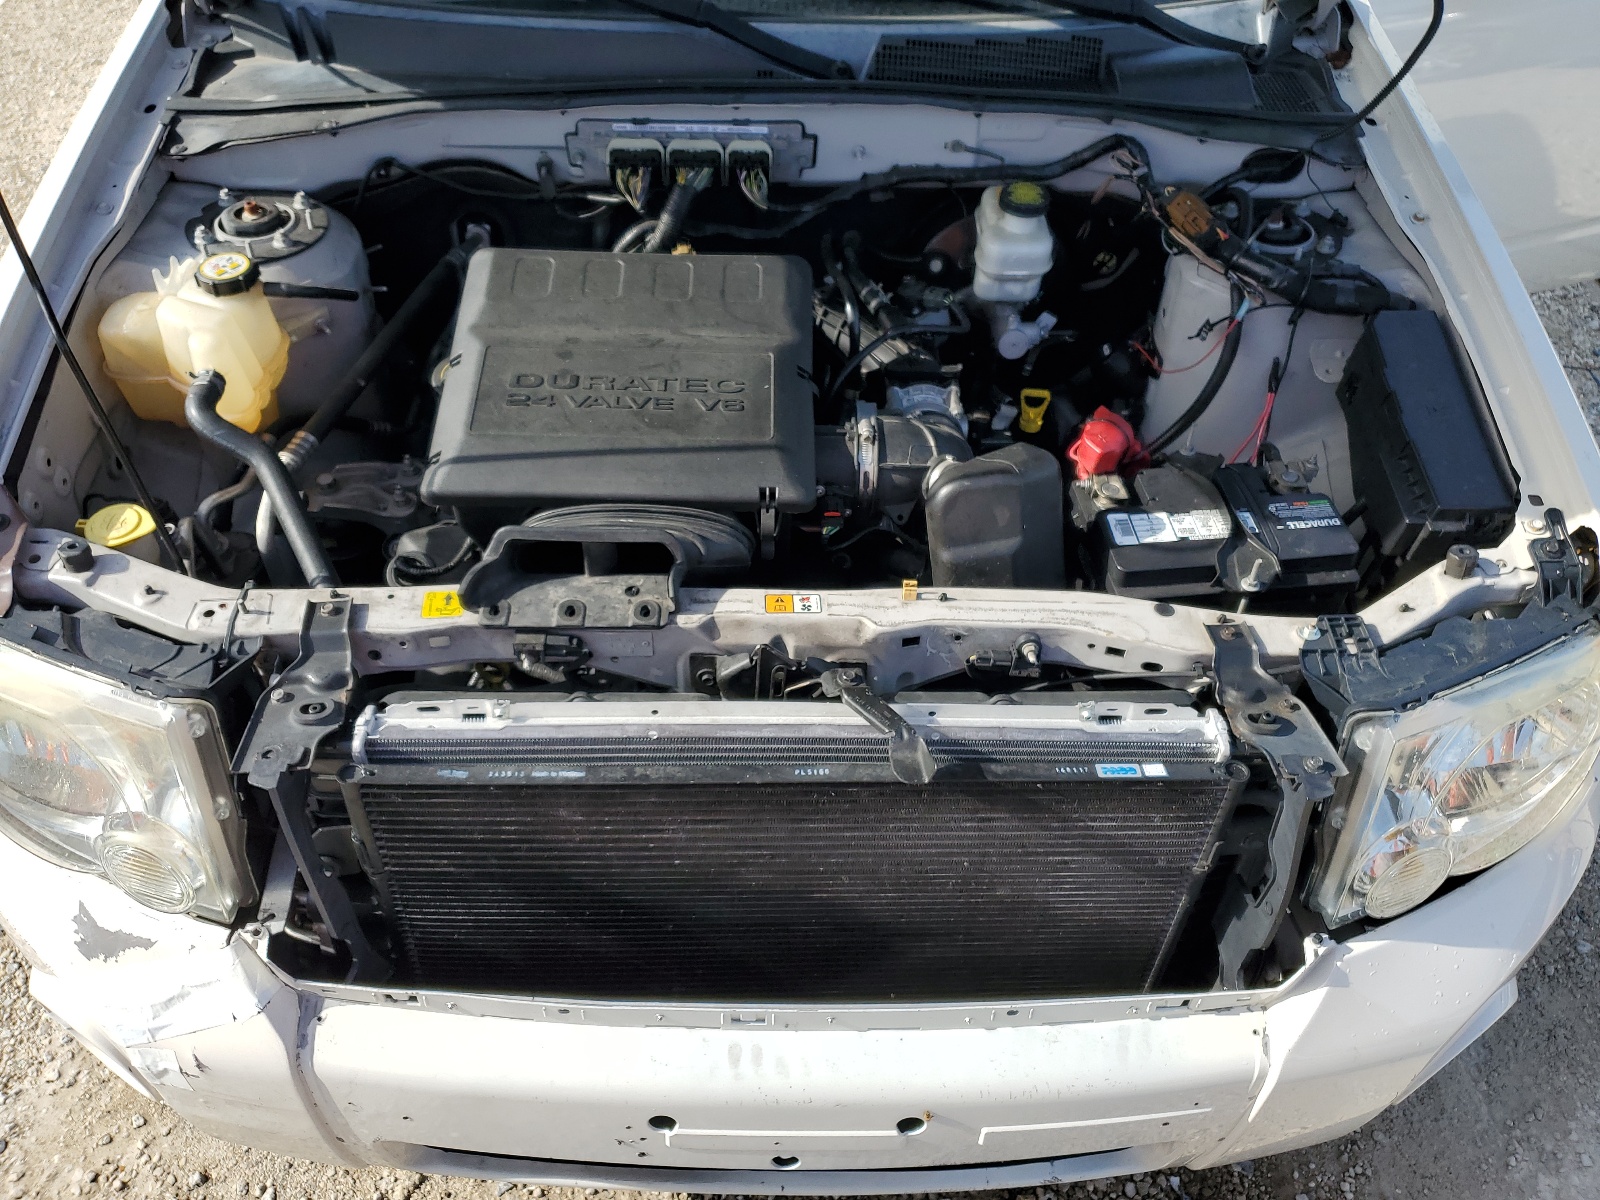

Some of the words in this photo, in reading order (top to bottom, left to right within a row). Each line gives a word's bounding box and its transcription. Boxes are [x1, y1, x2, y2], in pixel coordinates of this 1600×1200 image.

[508, 373, 746, 394] DURATEC
[506, 392, 557, 408] 24
[564, 394, 675, 410] VALVE
[694, 397, 746, 412] V6
[1286, 517, 1341, 530] DURACELL
